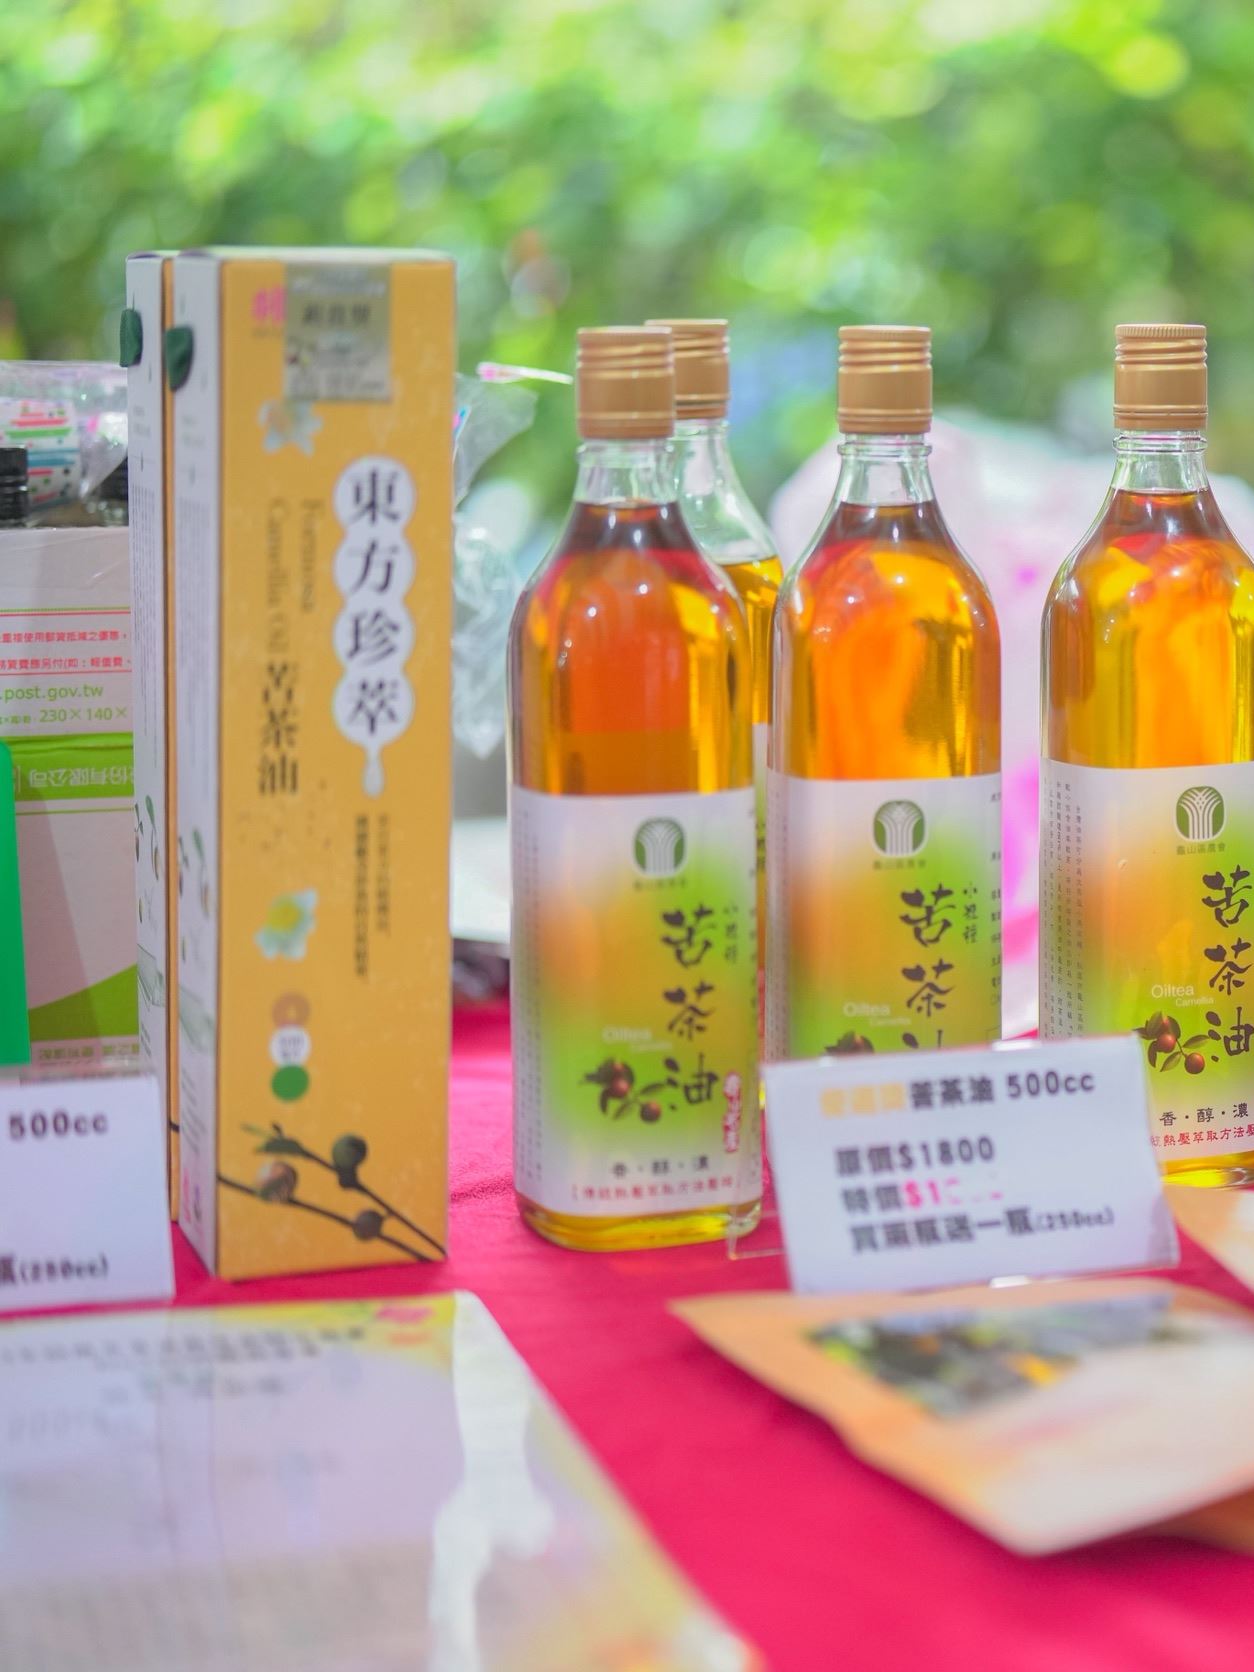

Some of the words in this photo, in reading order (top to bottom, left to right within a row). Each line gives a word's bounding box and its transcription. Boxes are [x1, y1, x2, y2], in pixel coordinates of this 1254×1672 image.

[347, 469, 403, 736] 東方珍萃
[258, 658, 300, 796] 苦茶油
[29, 766, 134, 788] 份有限公司
[899, 883, 958, 1049] 苦茶
[661, 903, 718, 1112] 苦茶油
[1151, 984, 1195, 999] Oiltea
[1175, 996, 1214, 1008] Camellia
[1006, 1070, 1096, 1100] 500cc
[9, 1110, 108, 1139] 500cc
[836, 1136, 996, 1178] 原價$1800
